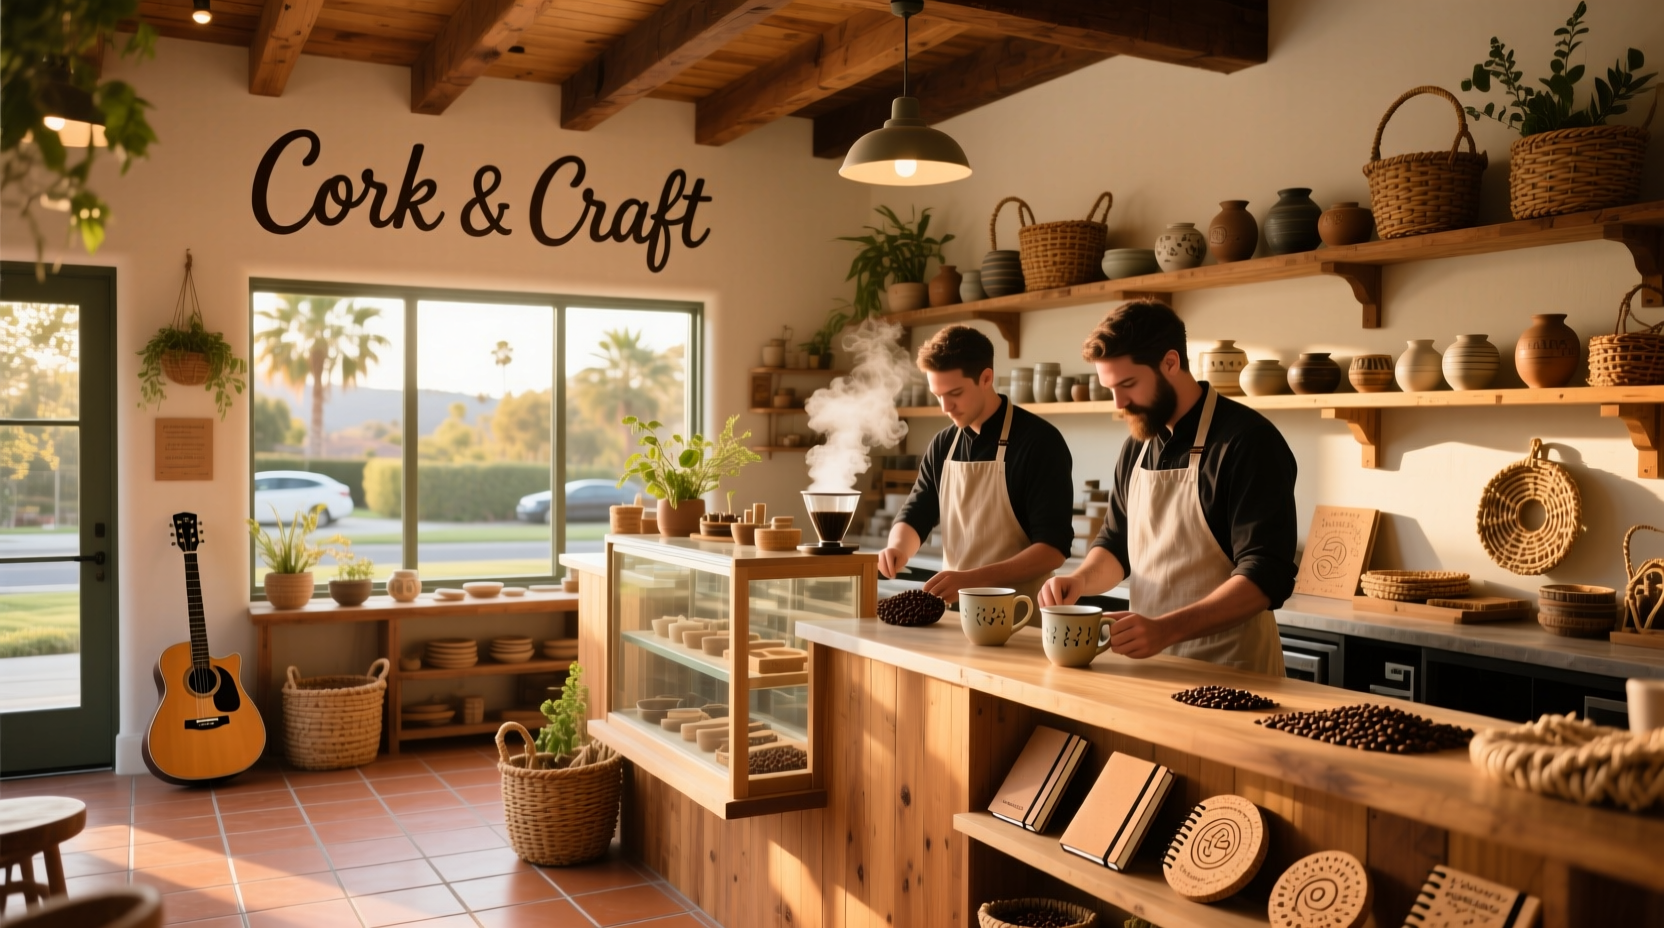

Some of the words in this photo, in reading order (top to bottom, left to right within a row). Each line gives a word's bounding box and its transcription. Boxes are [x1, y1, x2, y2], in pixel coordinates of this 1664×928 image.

[251, 129, 445, 235] Cork
[460, 165, 513, 237] &
[529, 155, 713, 273] Craft
